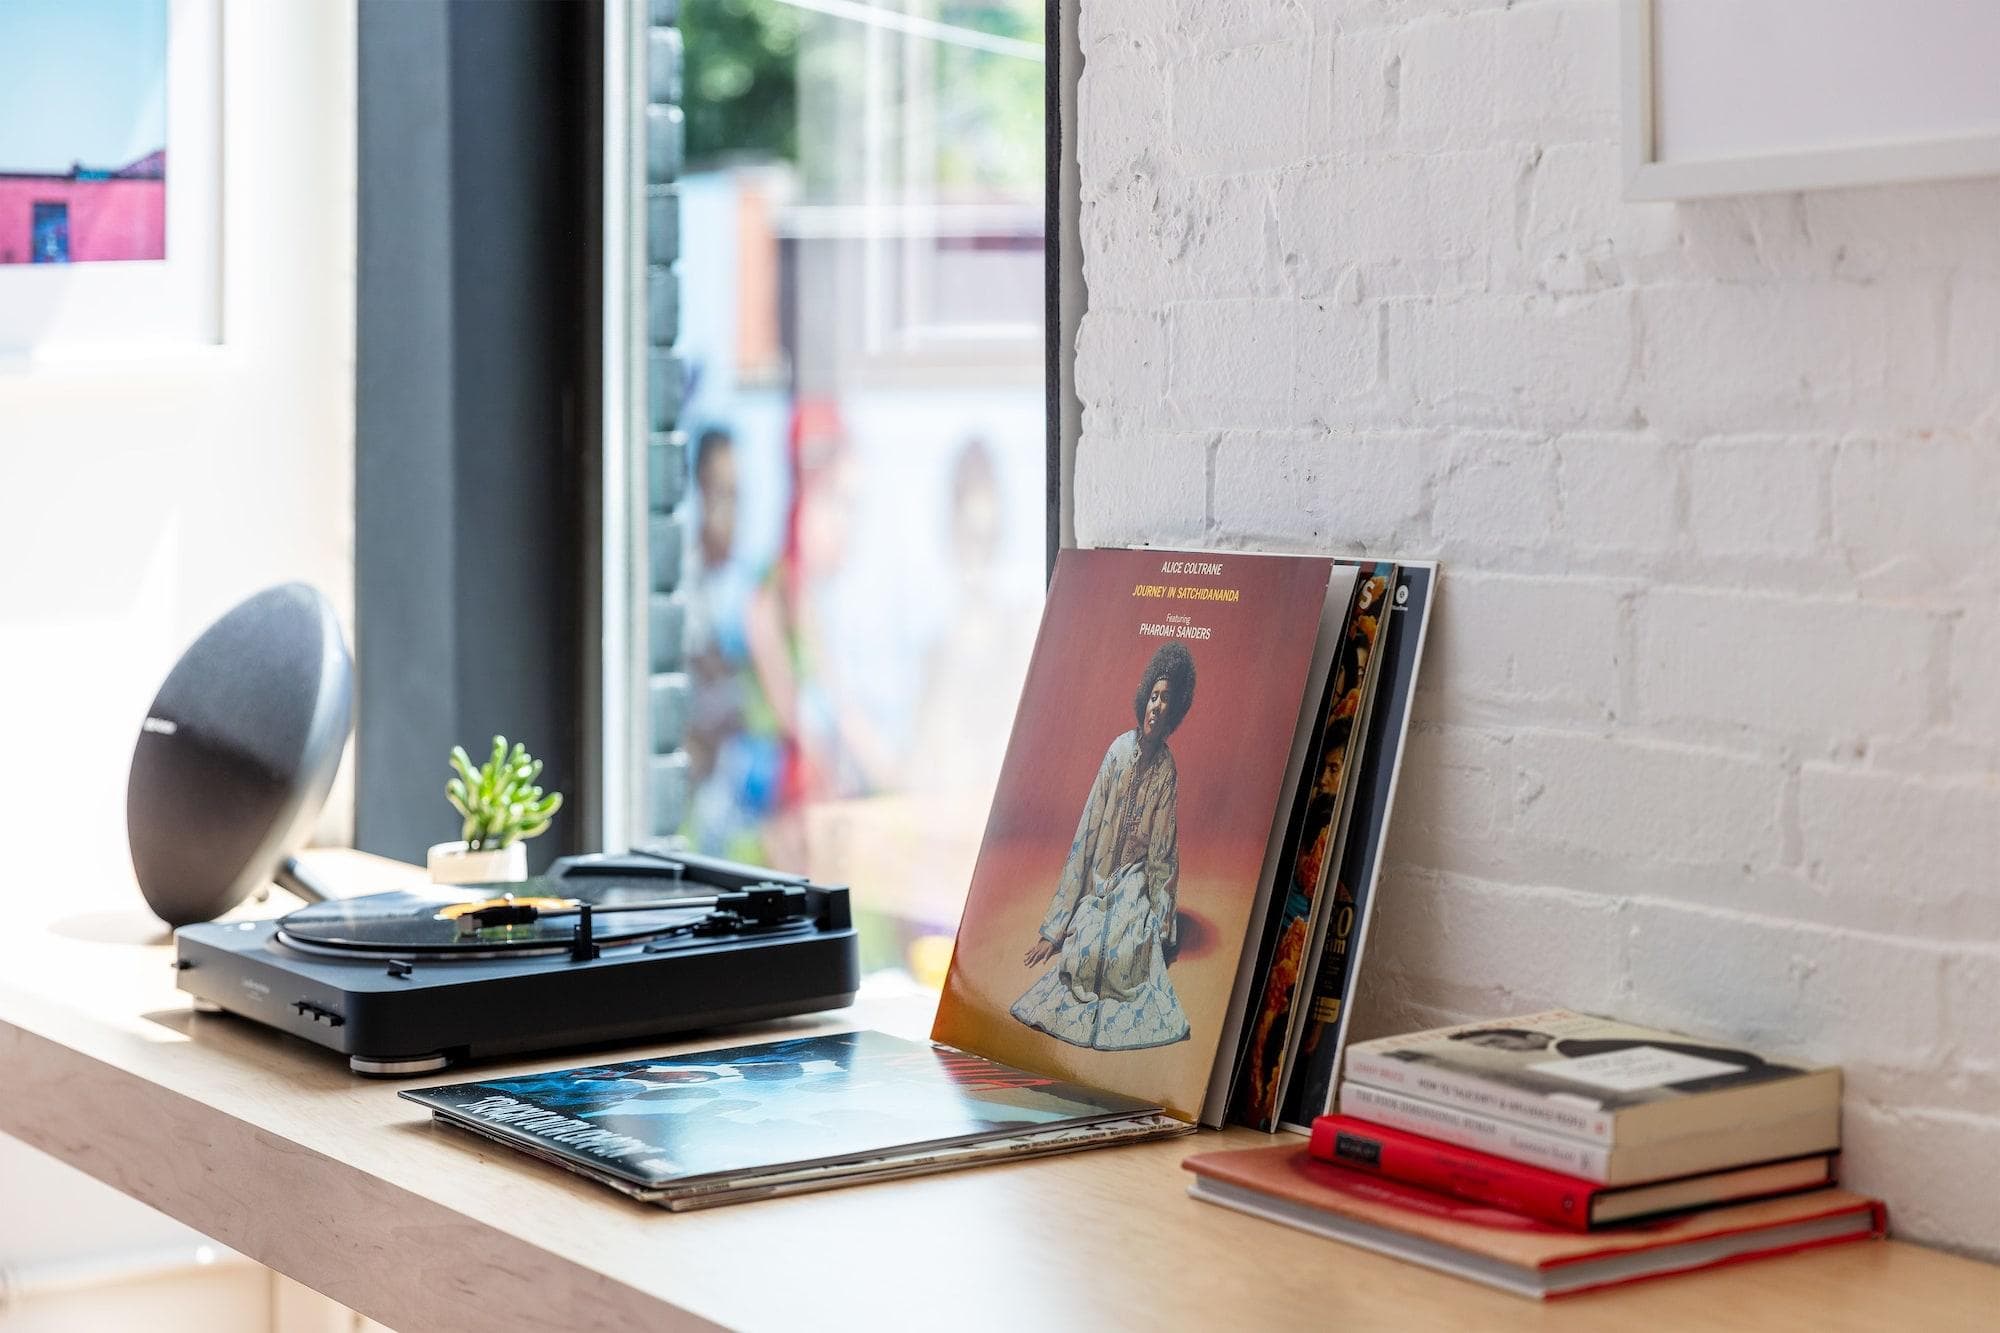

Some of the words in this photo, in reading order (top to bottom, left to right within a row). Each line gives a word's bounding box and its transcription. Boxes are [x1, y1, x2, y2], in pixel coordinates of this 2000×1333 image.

[1161, 561, 1184, 574] ALICE
[1184, 562, 1223, 576] COLTRANE
[1132, 584, 1167, 599] JOURNEY
[1167, 586, 1177, 598] IN
[1177, 586, 1240, 602] SATCHIDANANDA
[1166, 612, 1192, 626] Featuring
[1139, 623, 1176, 638] PHAROAH
[1176, 625, 1212, 640] SANDERS
